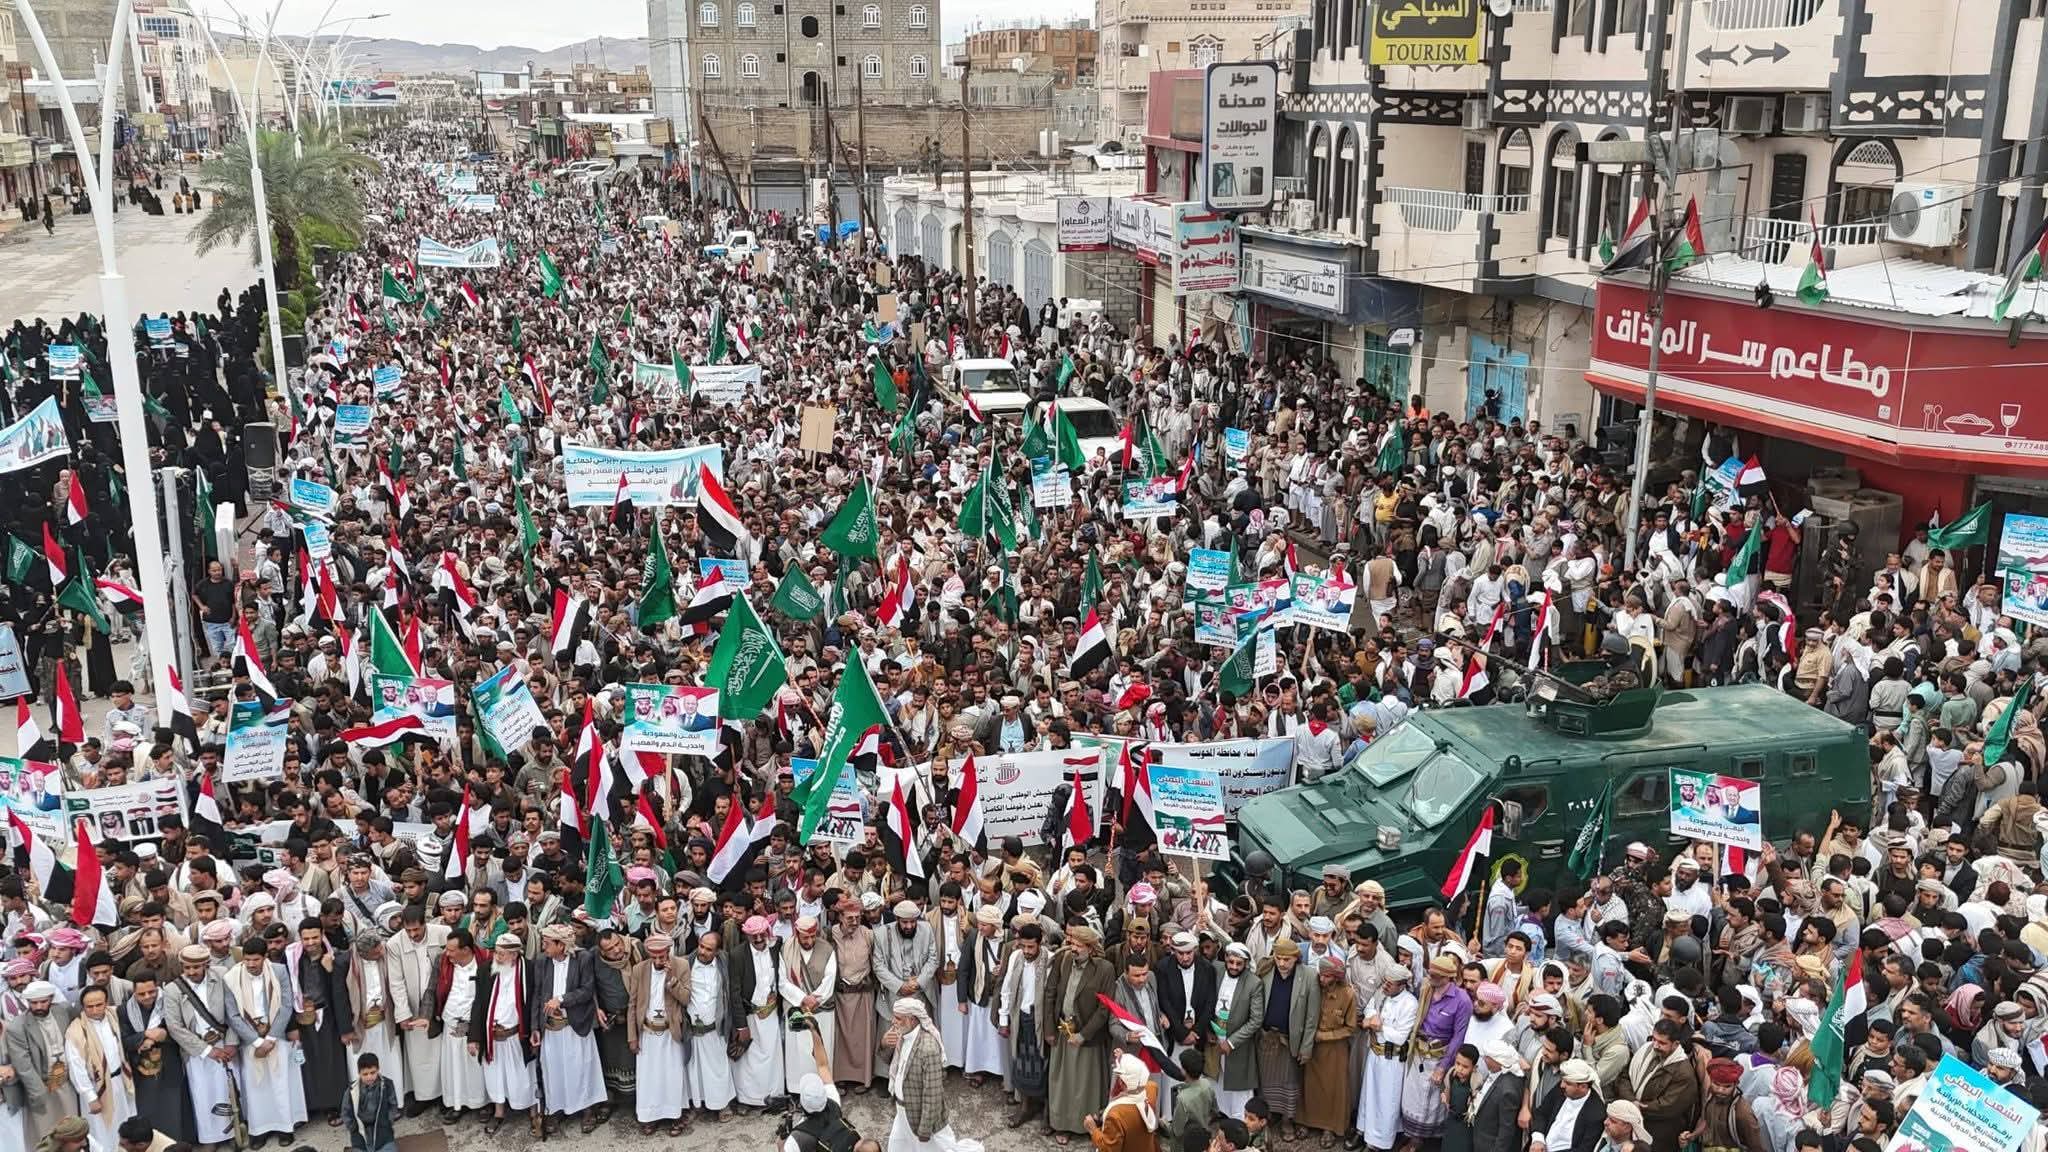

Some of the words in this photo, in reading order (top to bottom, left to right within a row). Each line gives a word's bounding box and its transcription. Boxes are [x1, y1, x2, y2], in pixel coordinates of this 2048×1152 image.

[1386, 44, 1468, 61] TOURISM
[1229, 72, 1258, 87] مركز
[1218, 93, 1267, 108] هدنة
[1216, 120, 1268, 137] للجوالات
[1180, 250, 1236, 274] والسلام
[1322, 264, 1336, 278] مركز
[1312, 277, 1335, 297] هدنة
[1605, 309, 1697, 355] المذاق
[1698, 333, 1767, 368] سر
[1770, 344, 1891, 398] مطاعم
[1984, 1096, 2023, 1125] الشعب
